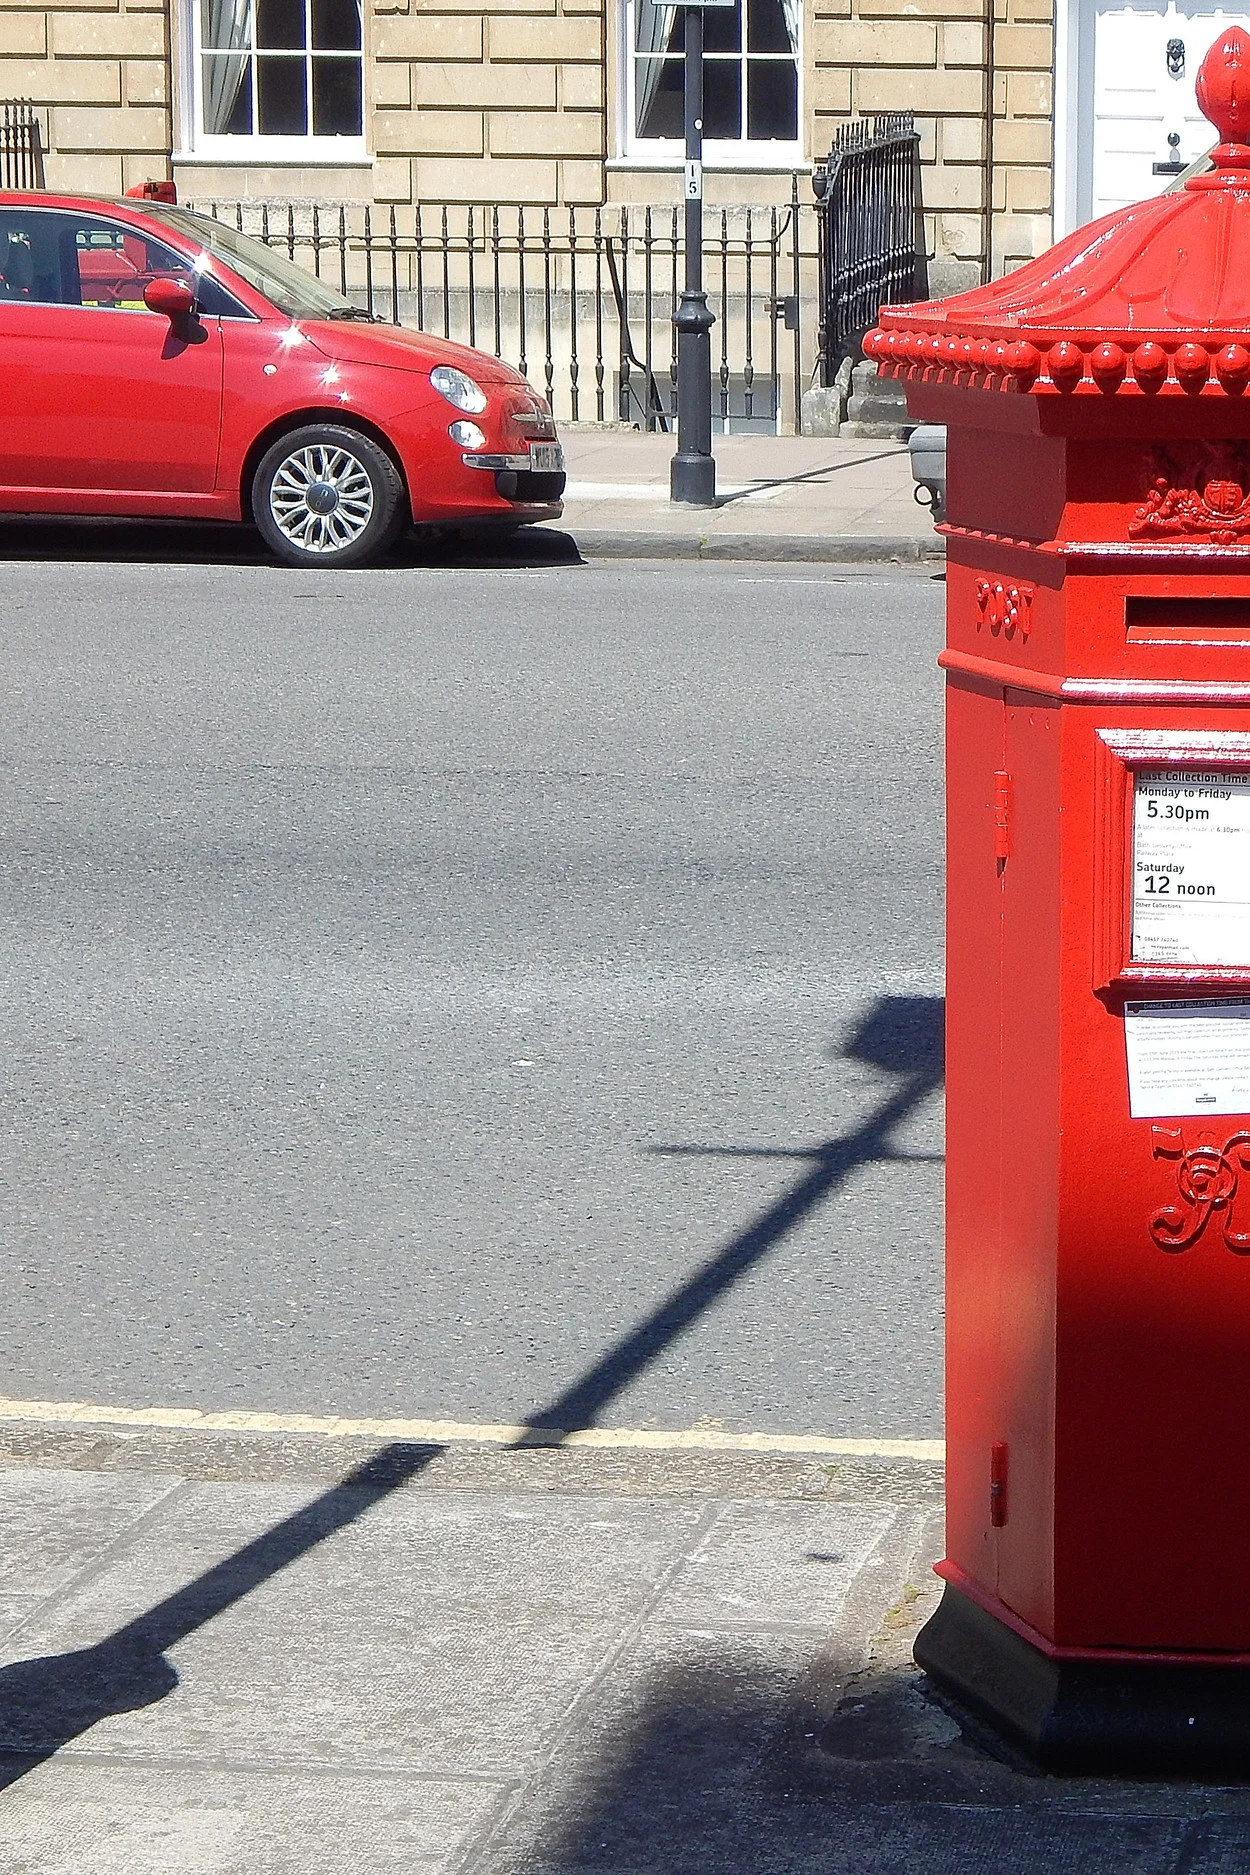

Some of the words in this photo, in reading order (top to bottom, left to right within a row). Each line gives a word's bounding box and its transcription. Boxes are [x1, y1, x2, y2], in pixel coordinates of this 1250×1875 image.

[975, 577, 1034, 635] POST
[1139, 771, 1162, 781] Last
[1166, 771, 1218, 783] Collection
[1220, 773, 1248, 784] Time
[1138, 786, 1180, 799] Monday
[1183, 788, 1194, 798] to
[1198, 788, 1232, 801] Friday
[1147, 800, 1209, 822] 5.30pm
[1136, 861, 1185, 875] Saturday
[1144, 875, 1170, 894] 12
[1177, 884, 1215, 896] noon
